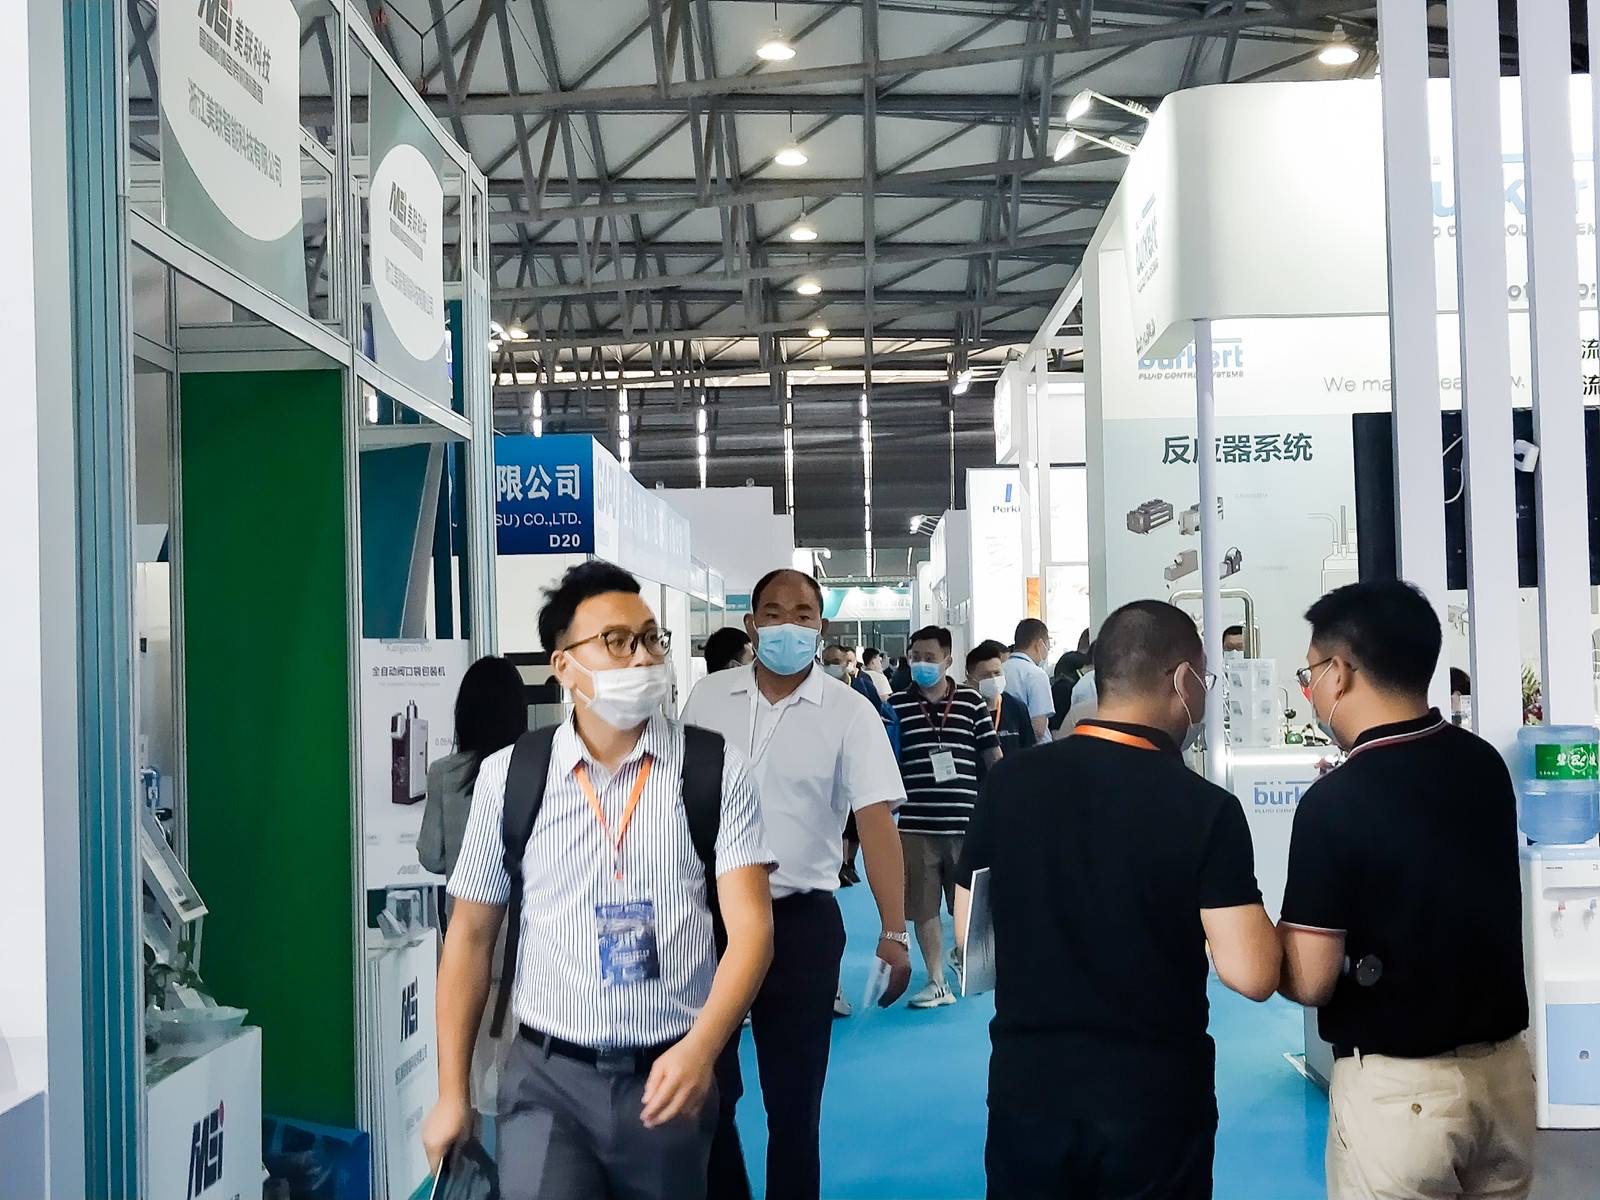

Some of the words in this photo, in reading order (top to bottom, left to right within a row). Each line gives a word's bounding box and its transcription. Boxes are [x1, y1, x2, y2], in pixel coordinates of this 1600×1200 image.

[496, 464, 580, 502] 限公司
[549, 533, 581, 548] D20
